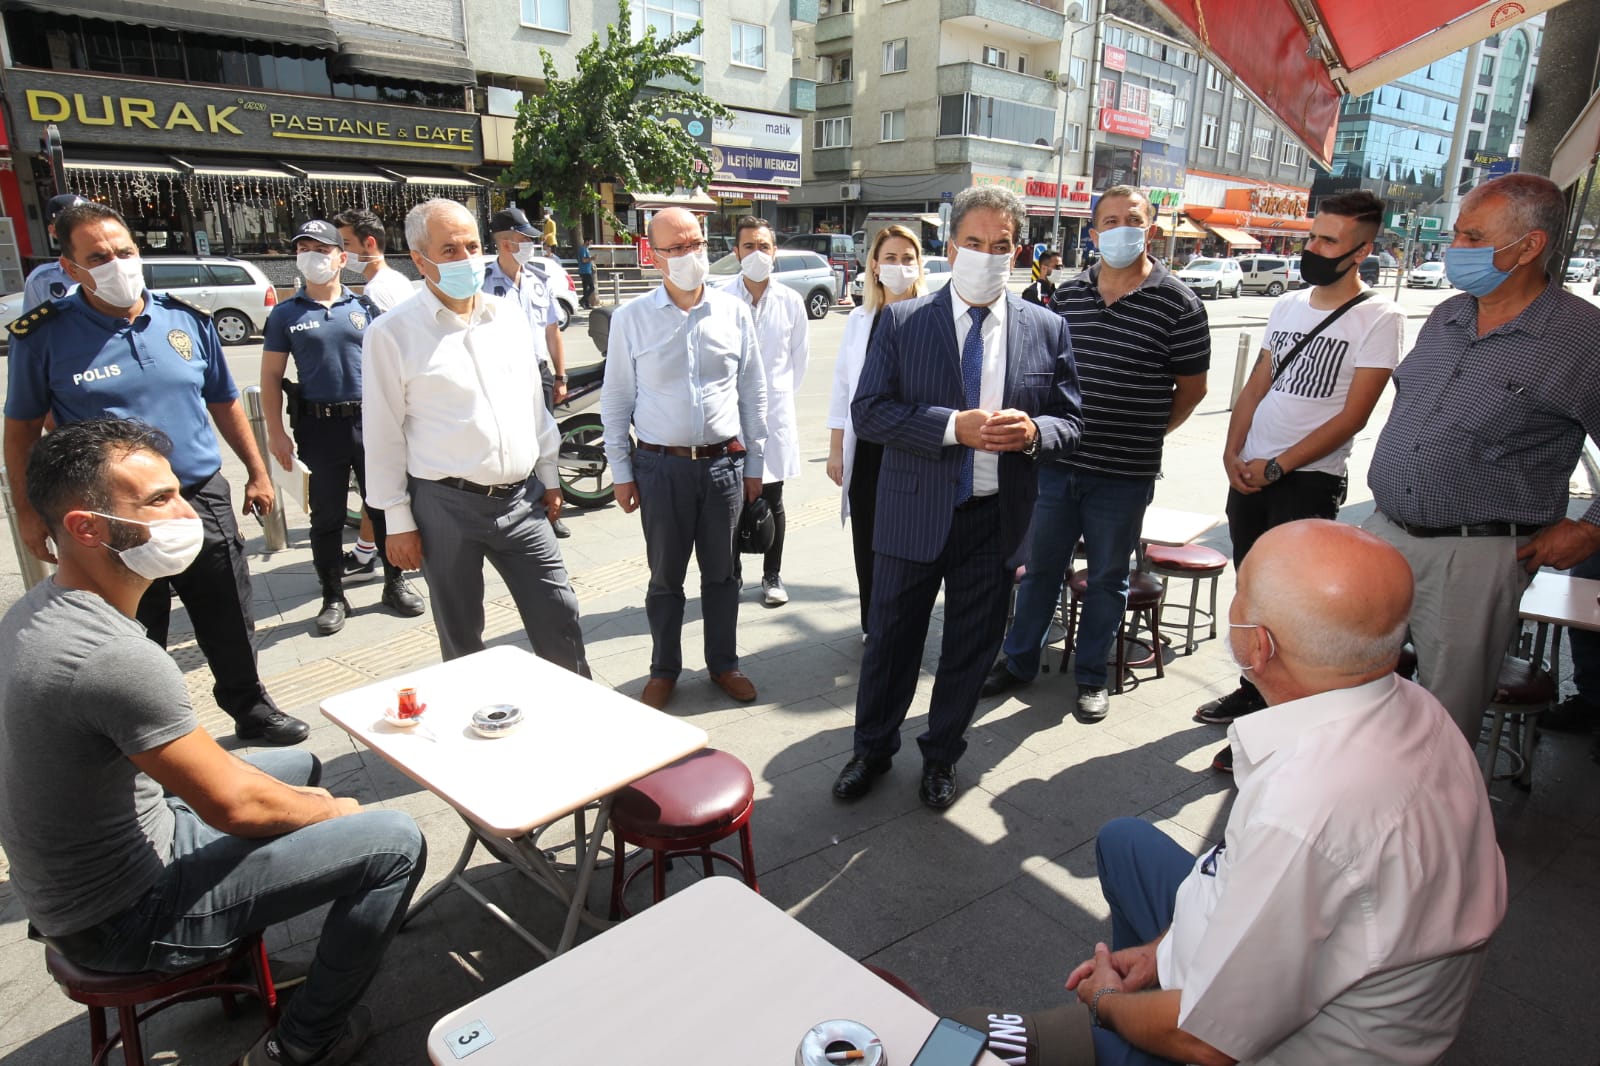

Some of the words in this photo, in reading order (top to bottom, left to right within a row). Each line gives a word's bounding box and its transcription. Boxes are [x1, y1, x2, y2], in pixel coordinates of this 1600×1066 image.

[25, 89, 245, 136] DURAK
[270, 113, 390, 138] PASTANE
[397, 128, 408, 138] &
[415, 125, 474, 144] CAFE
[765, 123, 791, 135] matik
[727, 151, 763, 171] İLETİŞİM
[764, 158, 799, 172] MERKEZİ
[1026, 176, 1069, 199] ÖZDEMR
[289, 319, 320, 334] POLİS
[458, 1031, 479, 1045] 3
[987, 1014, 1027, 1066] ING
